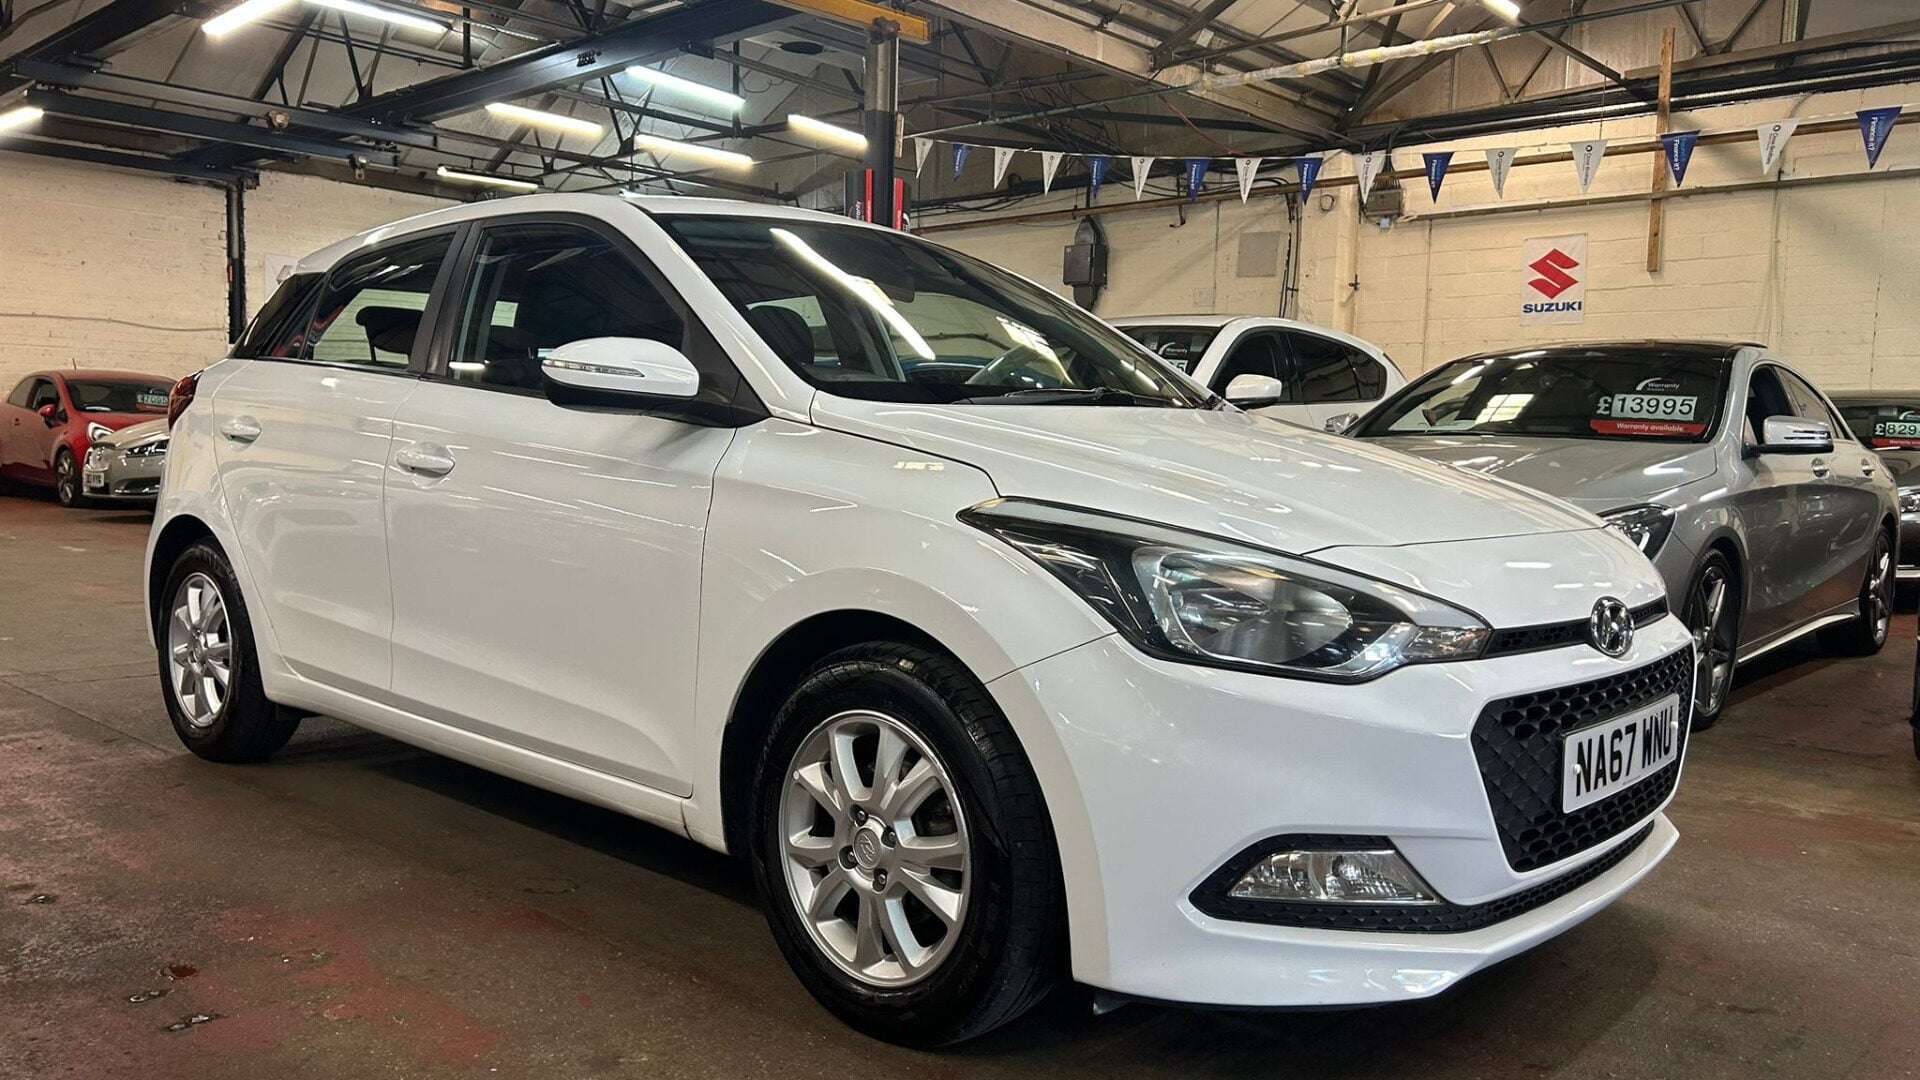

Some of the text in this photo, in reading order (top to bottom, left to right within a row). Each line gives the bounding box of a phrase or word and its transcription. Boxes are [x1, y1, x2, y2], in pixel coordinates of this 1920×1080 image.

[1523, 301, 1582, 313] SUZUKI
[1596, 396, 1693, 415] £13995
[1616, 422, 1649, 431] Warranty
[1875, 423, 1920, 435] £829
[1576, 705, 1674, 797] NA67 WNU
